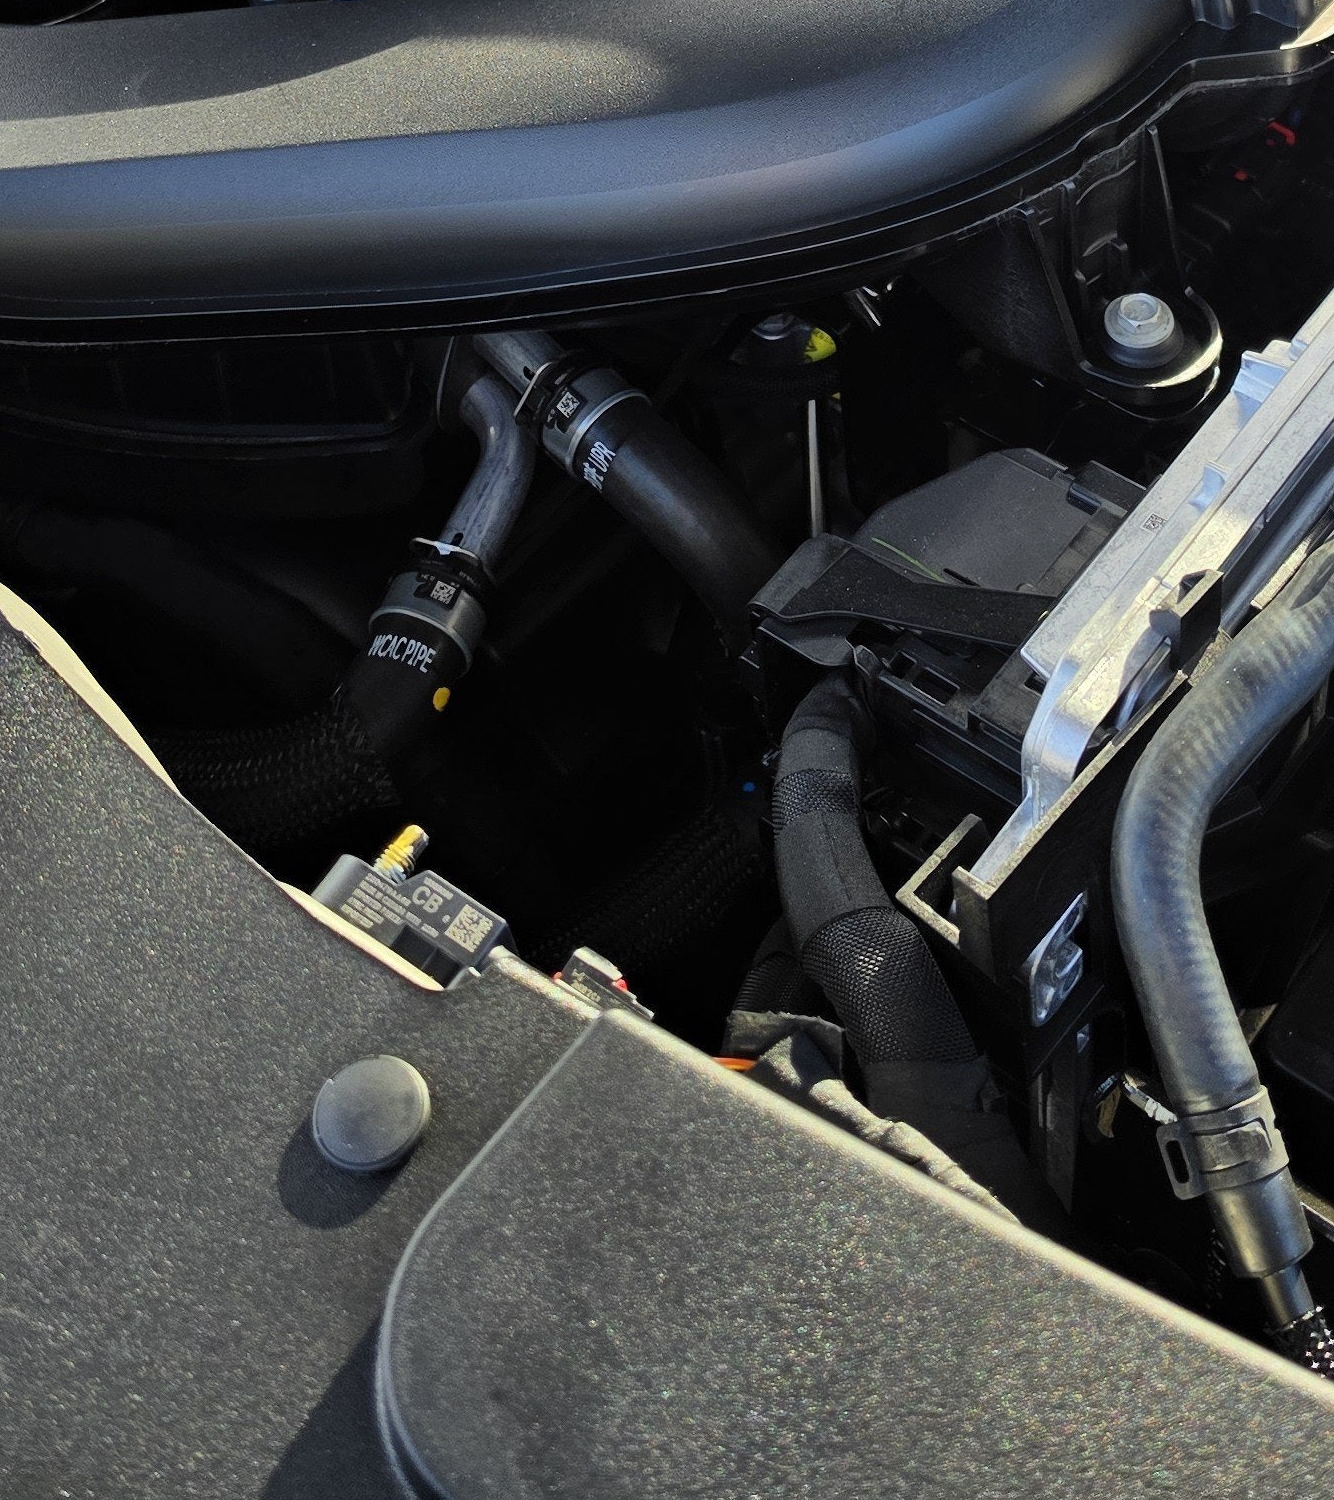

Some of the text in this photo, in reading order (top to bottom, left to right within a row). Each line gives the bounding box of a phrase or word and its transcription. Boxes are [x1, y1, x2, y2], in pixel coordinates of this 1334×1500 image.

[589, 441, 616, 472] UPR
[401, 639, 437, 673] PIPE
[411, 885, 444, 914] CB
